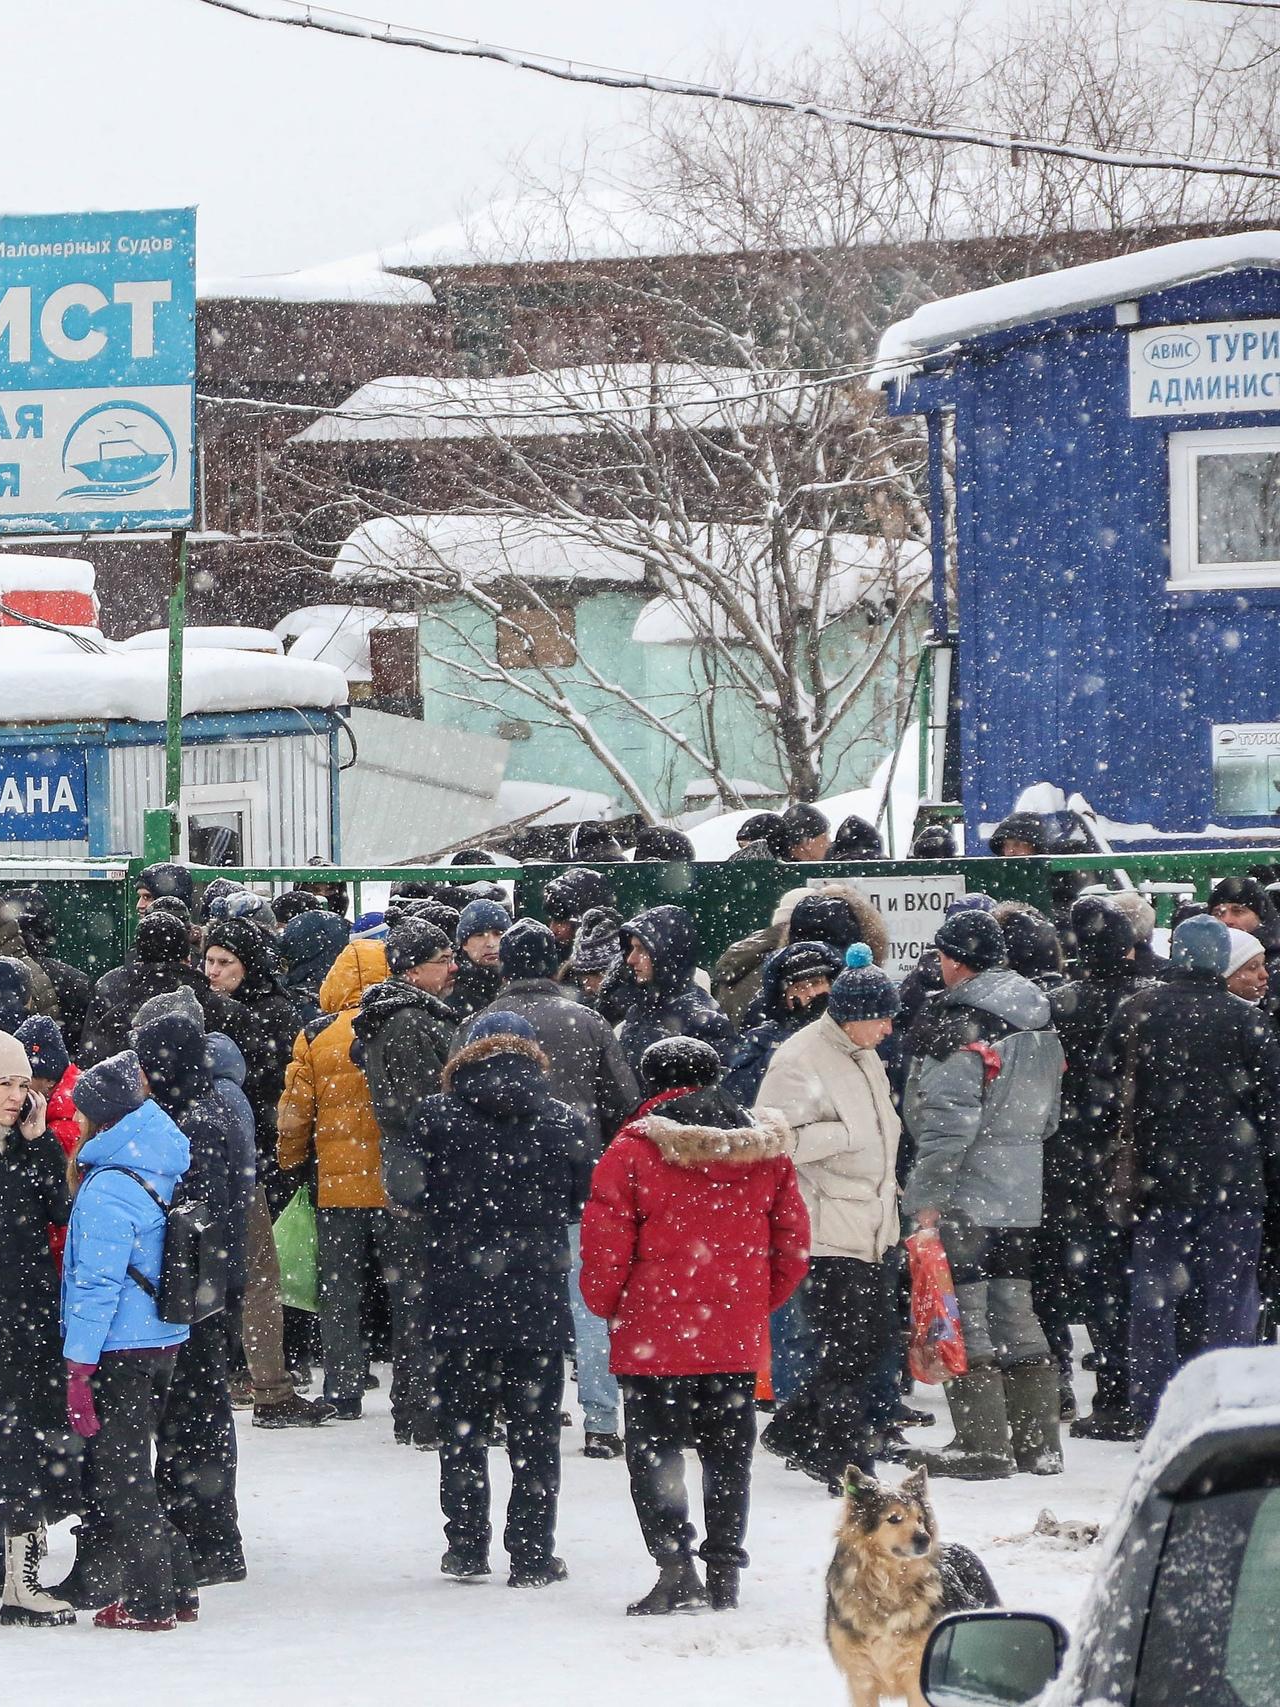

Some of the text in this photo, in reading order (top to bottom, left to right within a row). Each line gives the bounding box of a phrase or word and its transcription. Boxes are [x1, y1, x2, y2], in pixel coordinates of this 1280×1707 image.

[117, 236, 173, 256] Судов
[1151, 331, 1280, 363] АВМС ТУРИ
